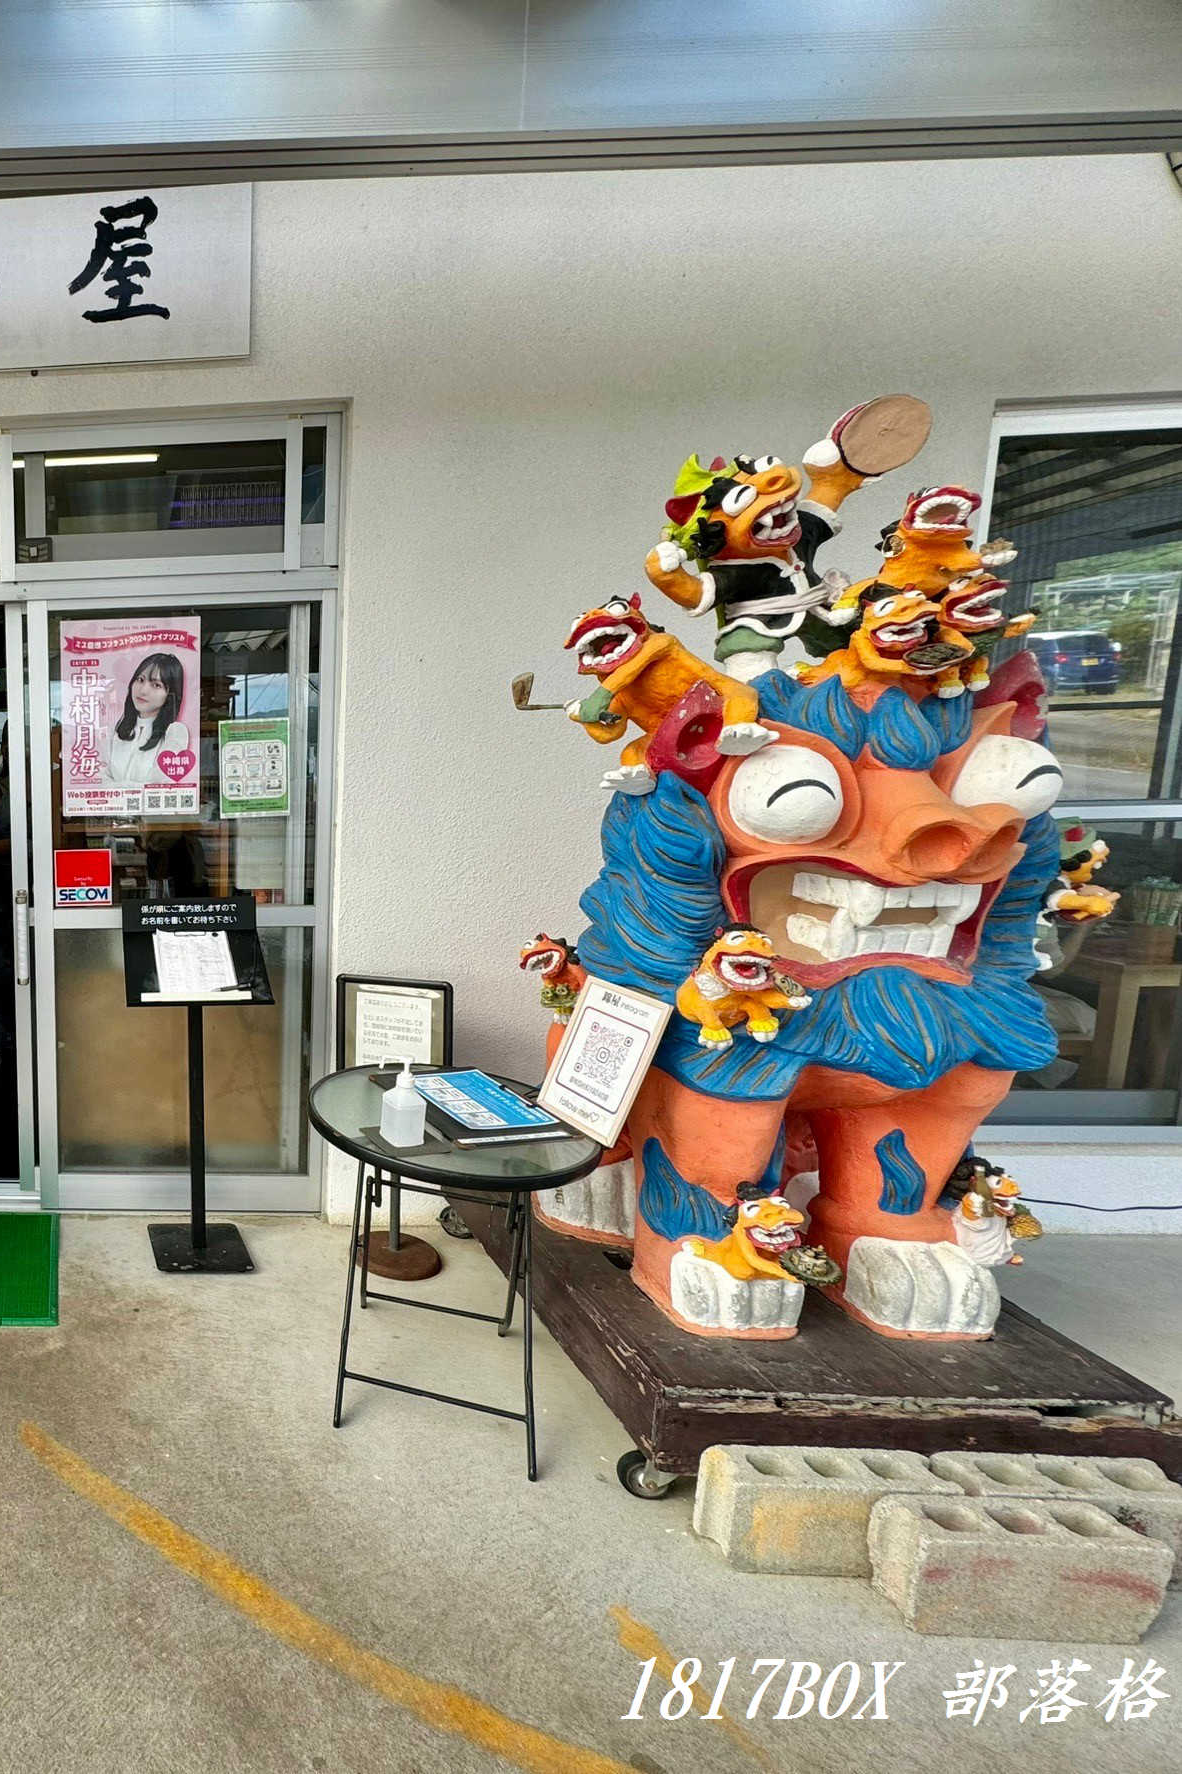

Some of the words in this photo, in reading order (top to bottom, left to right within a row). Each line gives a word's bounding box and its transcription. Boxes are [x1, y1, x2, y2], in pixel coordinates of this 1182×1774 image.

[69, 667, 100, 777] 中村月海
[59, 888, 108, 901] SECOM
